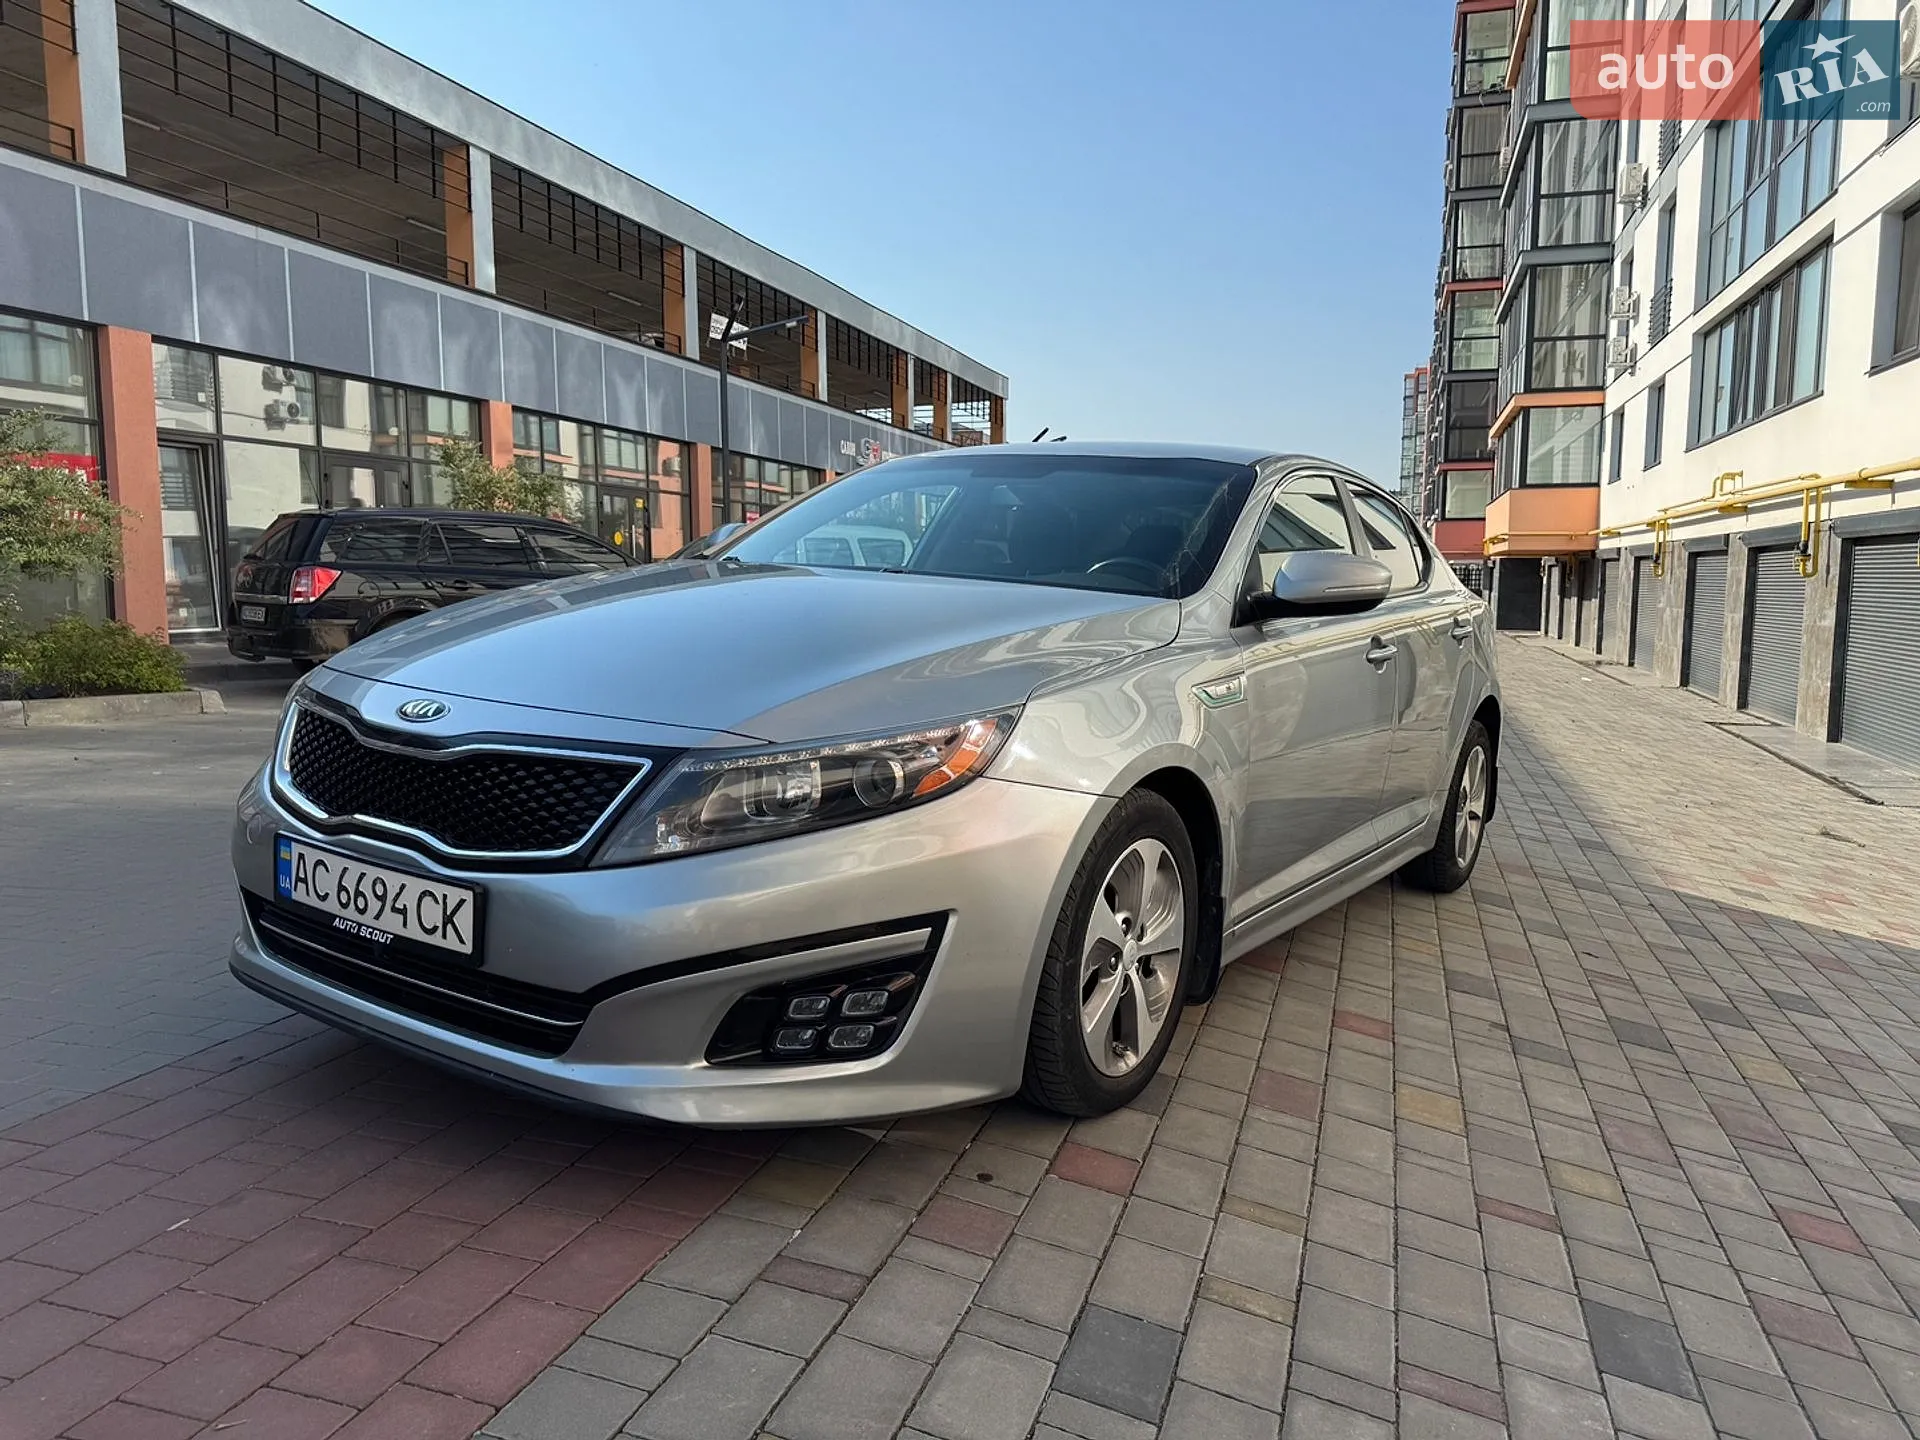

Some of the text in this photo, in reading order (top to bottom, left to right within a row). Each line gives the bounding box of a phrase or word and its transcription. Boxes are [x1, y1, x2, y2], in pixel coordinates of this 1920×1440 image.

[401, 700, 440, 717] KIA
[280, 874, 291, 889] UA
[333, 917, 394, 945] AUTO SCOUT
